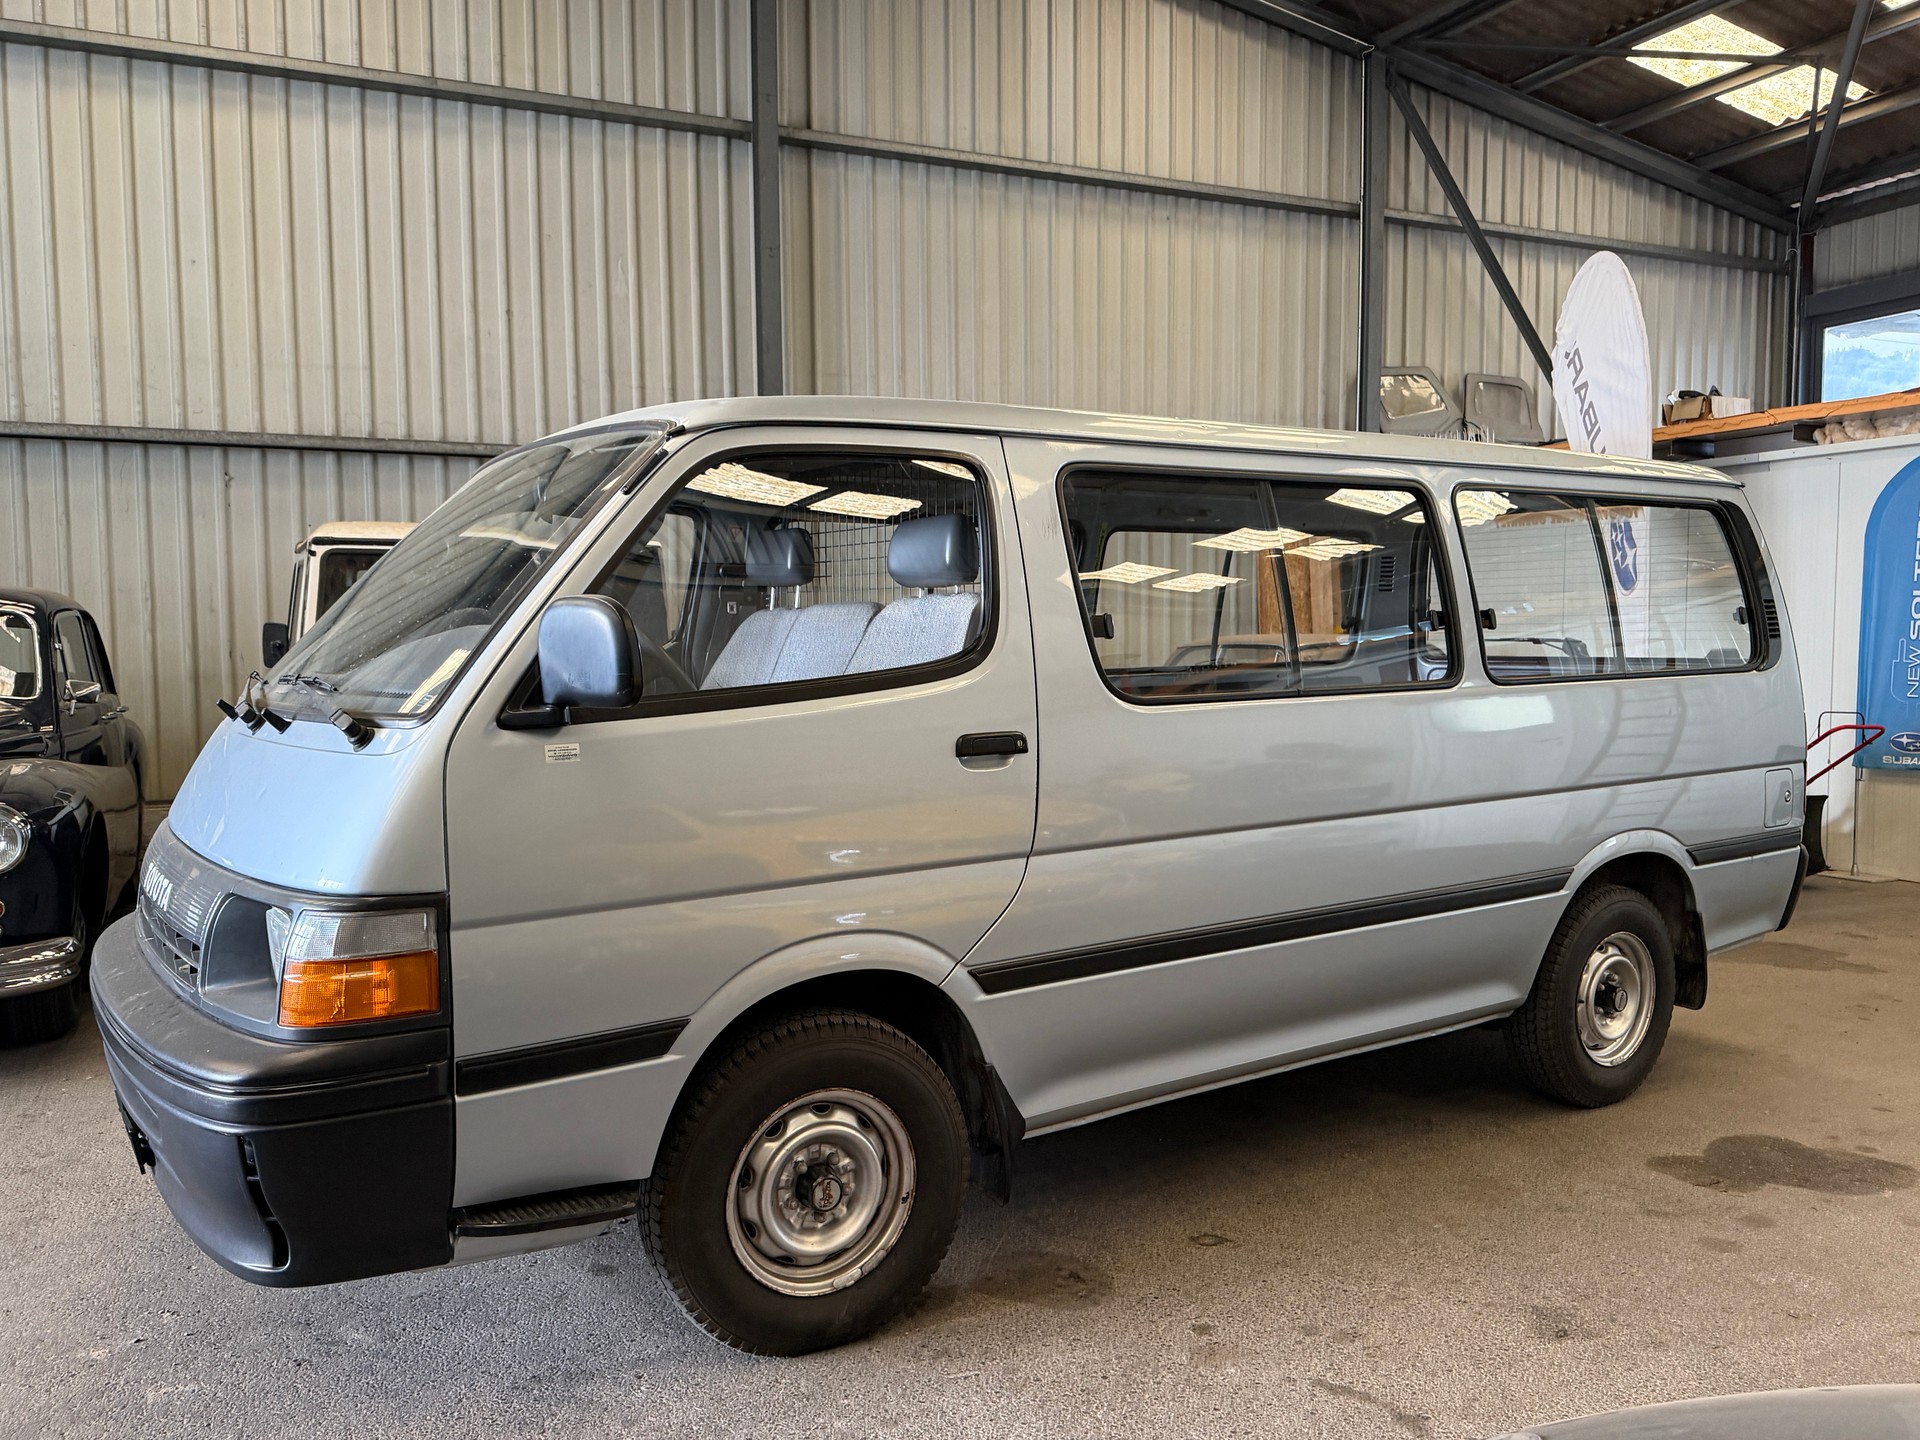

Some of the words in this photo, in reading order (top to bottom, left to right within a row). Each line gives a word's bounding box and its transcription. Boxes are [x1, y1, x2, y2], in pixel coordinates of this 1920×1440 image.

[1907, 645, 1920, 698] NEW
[1882, 755, 1920, 766] SUBA
[143, 861, 174, 912] TOYOTA
